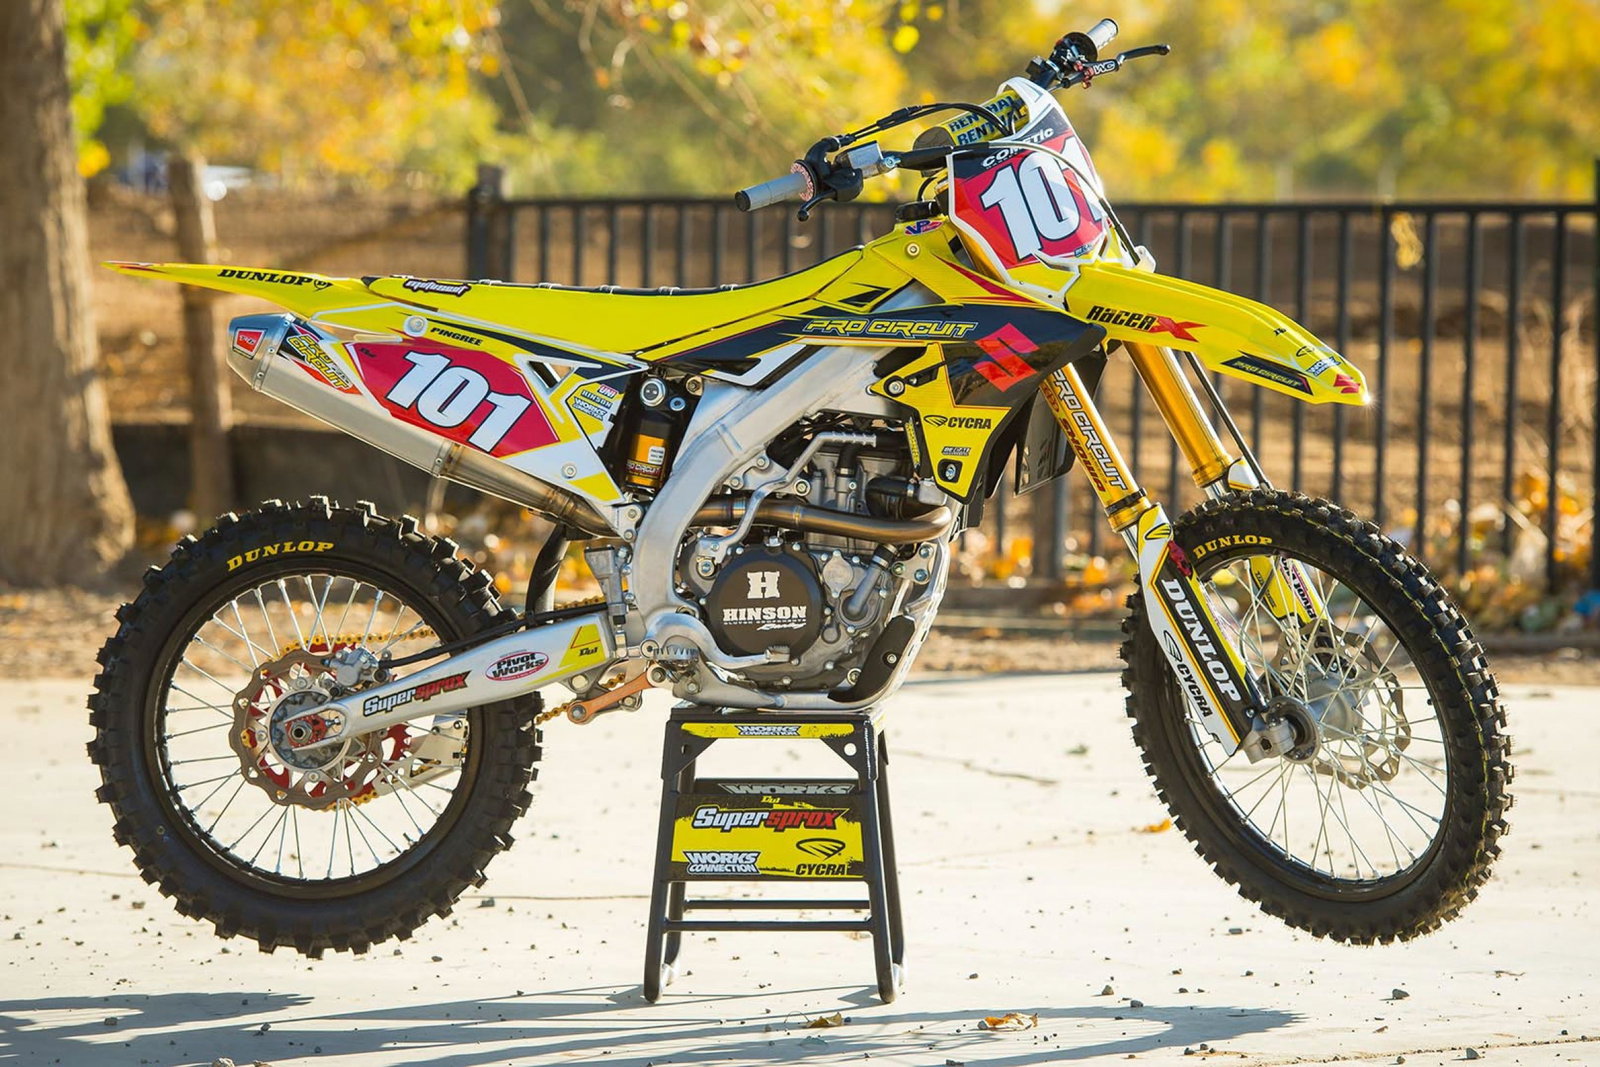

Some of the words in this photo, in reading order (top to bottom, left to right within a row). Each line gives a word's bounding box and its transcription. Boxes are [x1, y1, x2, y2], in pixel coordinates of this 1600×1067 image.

[980, 137, 1102, 262] 101
[217, 268, 314, 286] DUNLOP
[430, 327, 484, 347] PINGREE
[804, 319, 868, 335] PRO
[868, 320, 977, 338] CIRCUIT
[288, 337, 350, 389] CIRCUIT
[1258, 368, 1301, 388] CIRCUIT
[384, 351, 533, 453] 101
[598, 385, 618, 399] UNI
[948, 416, 991, 429] CYCRA
[1053, 369, 1082, 410] PRO
[1072, 410, 1128, 491] CIRCUIT
[227, 541, 334, 571] DUNLOP
[1193, 534, 1273, 559] DUNLOP
[747, 571, 780, 599] H
[723, 605, 807, 621] HINSON
[1161, 579, 1242, 701] DUNLOP
[492, 659, 545, 678] Works
[496, 652, 537, 670] Pivot
[363, 673, 468, 716] Supersprox
[1177, 663, 1214, 718] CYCRA
[727, 784, 851, 794] WORKS
[693, 807, 838, 832] Supersprox
[686, 852, 758, 863] WORKS
[689, 863, 758, 874] CONNECTION
[795, 863, 845, 876] CYCRA
